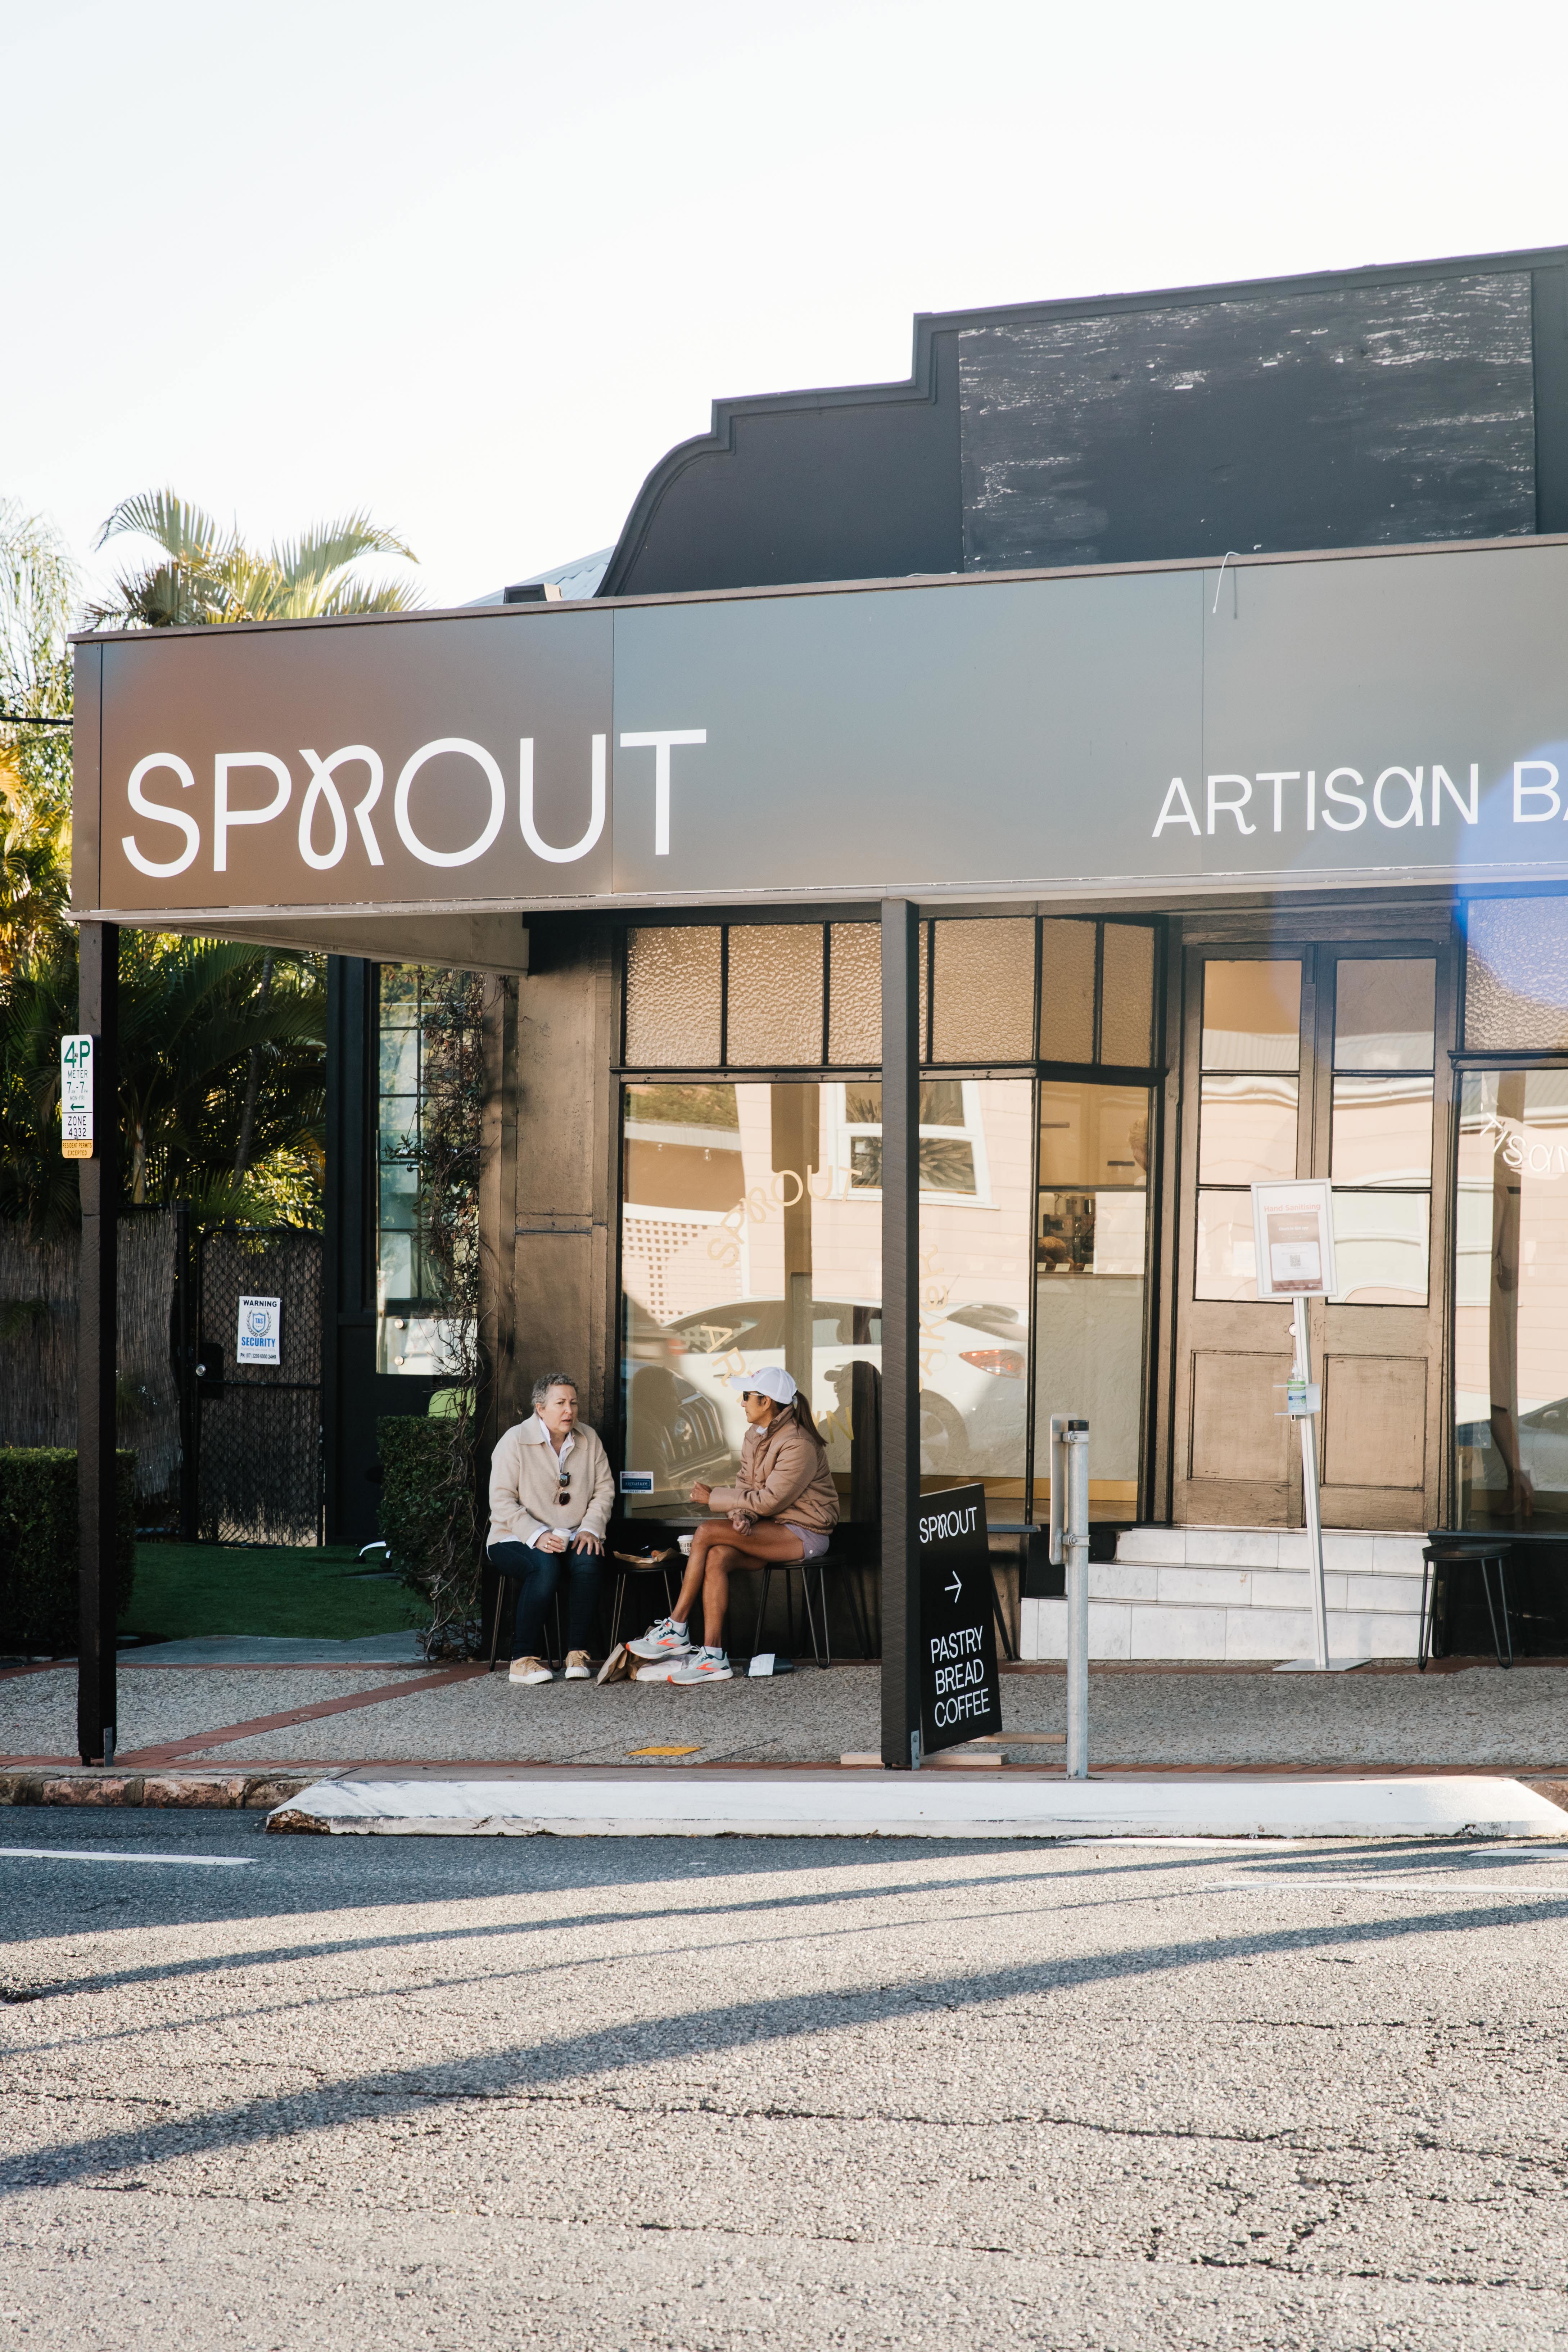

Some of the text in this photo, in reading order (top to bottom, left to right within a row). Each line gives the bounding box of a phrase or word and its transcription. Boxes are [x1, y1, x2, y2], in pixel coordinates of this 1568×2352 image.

[122, 729, 707, 878] SPROUT
[1513, 760, 1568, 822] B
[64, 1041, 91, 1068] 4P
[68, 1070, 88, 1078] METER
[68, 1116, 87, 1126] ZONE
[68, 1128, 86, 1137] 4332
[707, 1165, 862, 1269] SPROUT
[241, 1337, 275, 1347] SECURITY
[919, 1506, 977, 1544] SPROUT
[931, 1625, 983, 1663] PASTRY
[935, 1658, 984, 1695] BREAD
[935, 1688, 990, 1728] COFFEE
